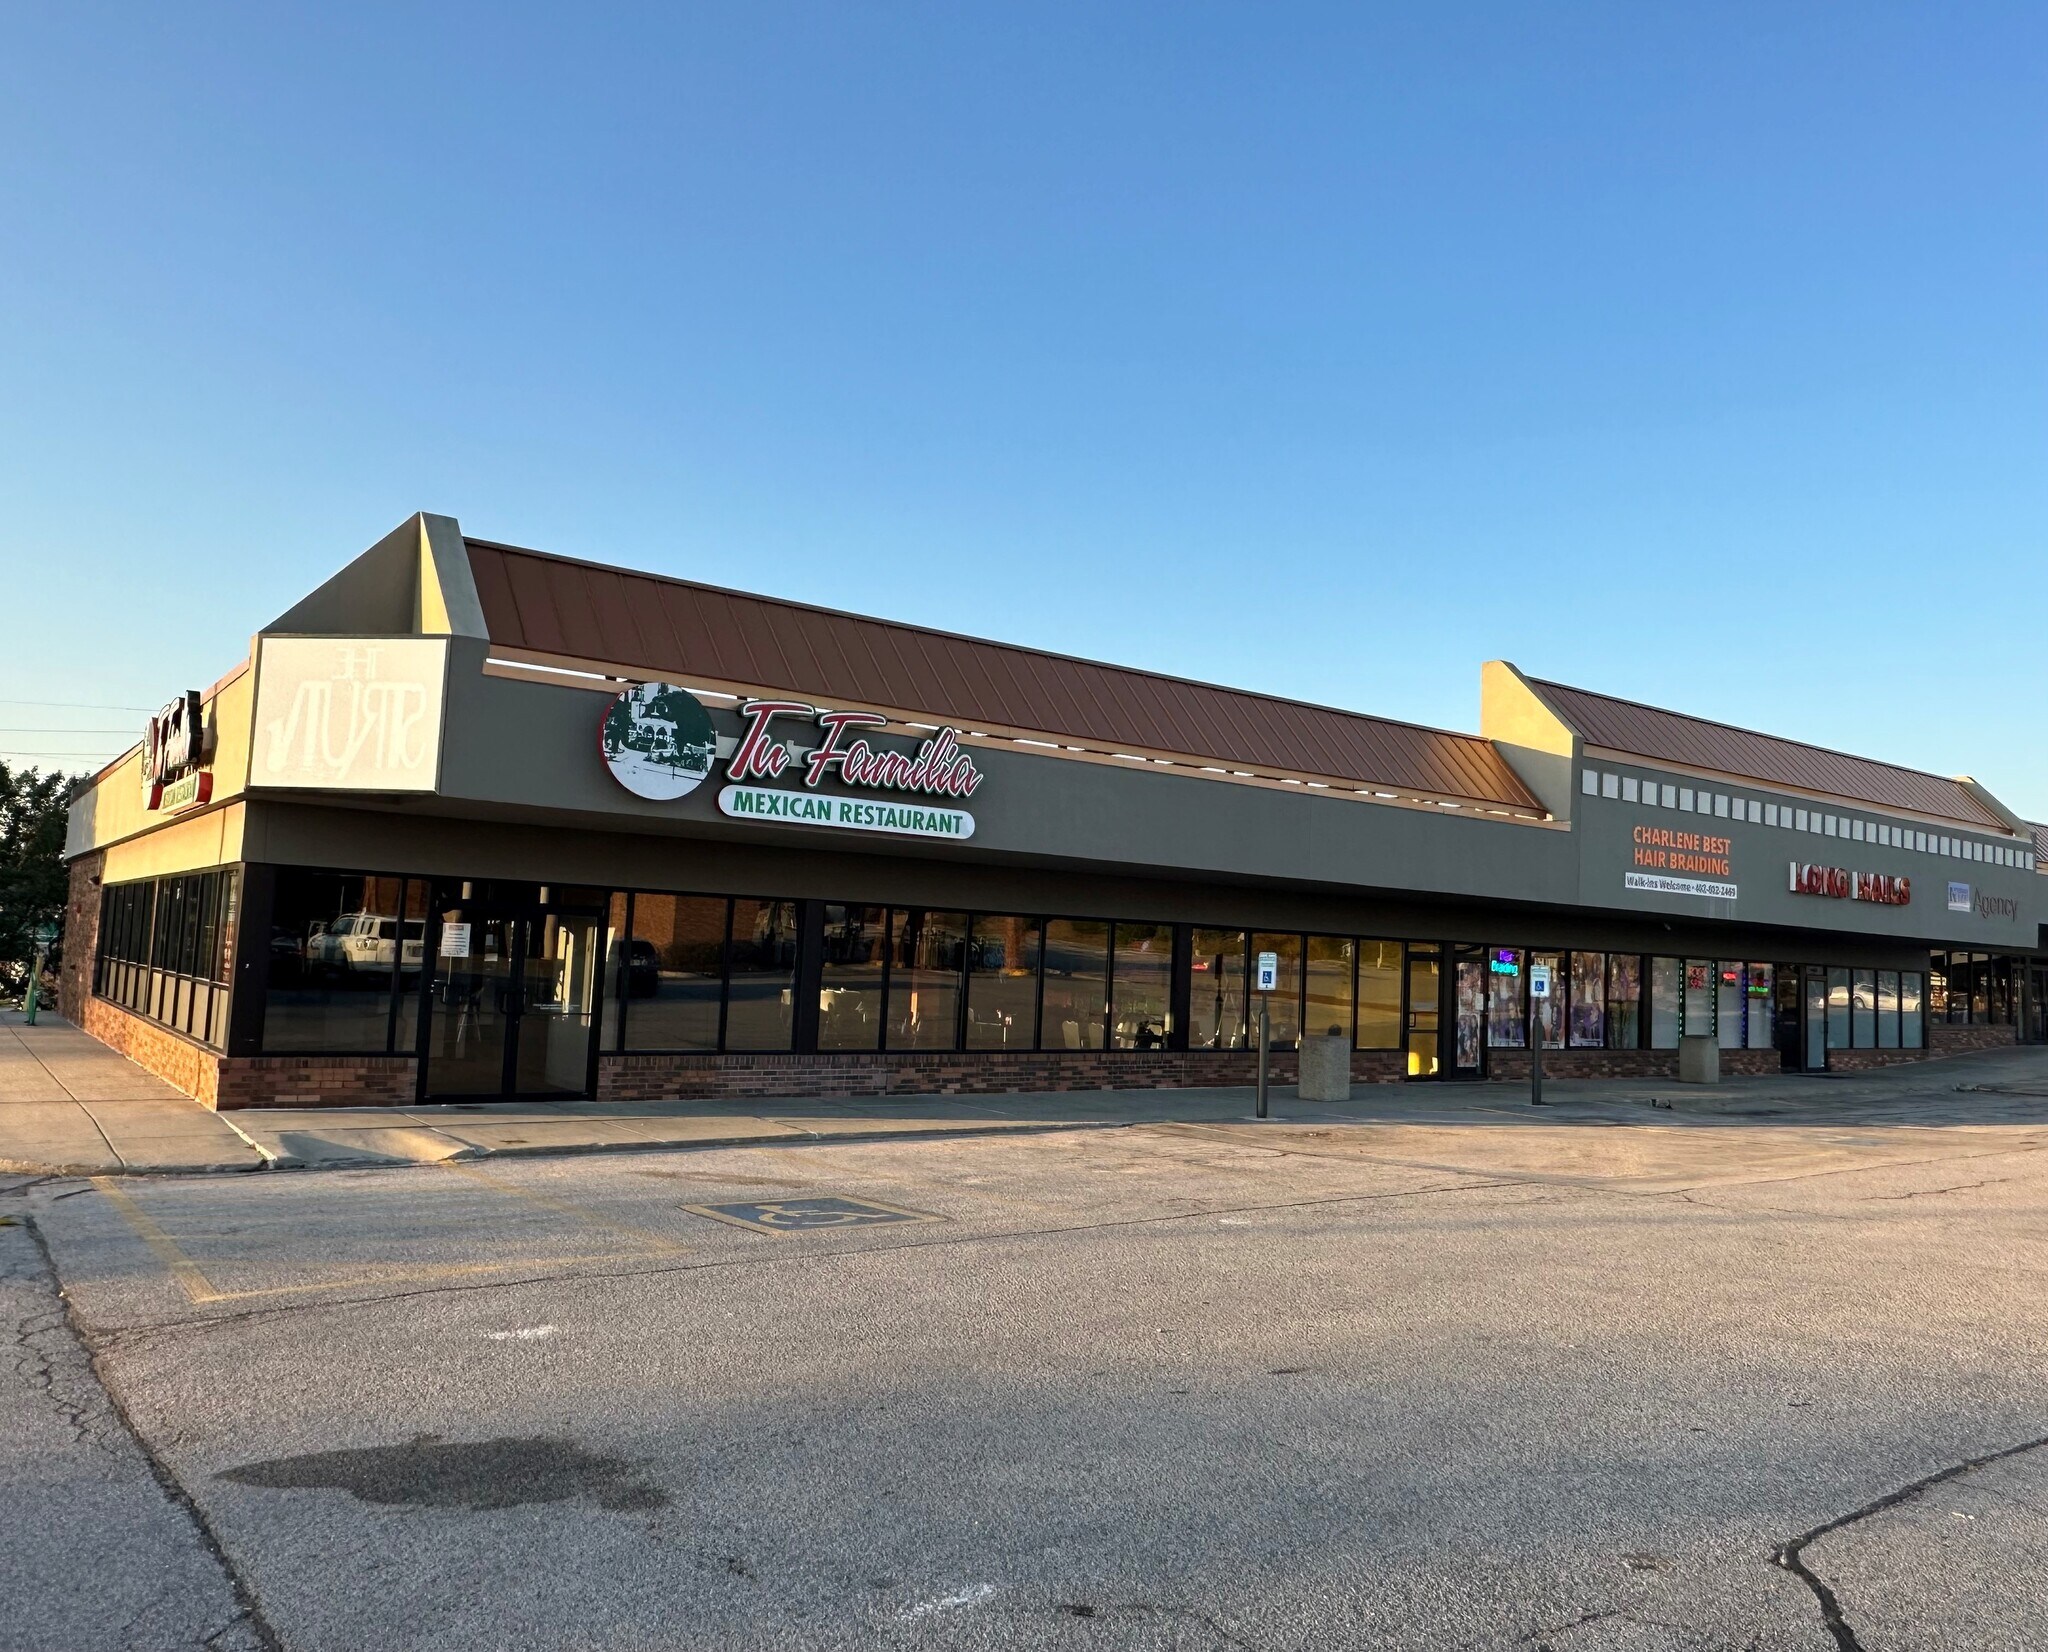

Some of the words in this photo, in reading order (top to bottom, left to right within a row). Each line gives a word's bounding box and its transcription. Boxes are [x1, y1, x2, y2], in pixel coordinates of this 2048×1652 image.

[728, 700, 815, 782] Tu
[804, 711, 984, 798] Familia
[733, 791, 831, 821] MEXICAN
[839, 802, 963, 834] RESTAURANT
[1633, 826, 1700, 851] CHARLENE
[1703, 835, 1731, 855] BEST
[1634, 848, 1666, 867] HAIR
[1669, 852, 1729, 875] BRAIDING
[1659, 878, 1692, 892] Welcome
[1789, 861, 1849, 899] LONG
[1851, 871, 1911, 906] NAILS
[1973, 887, 2018, 922] Agency
